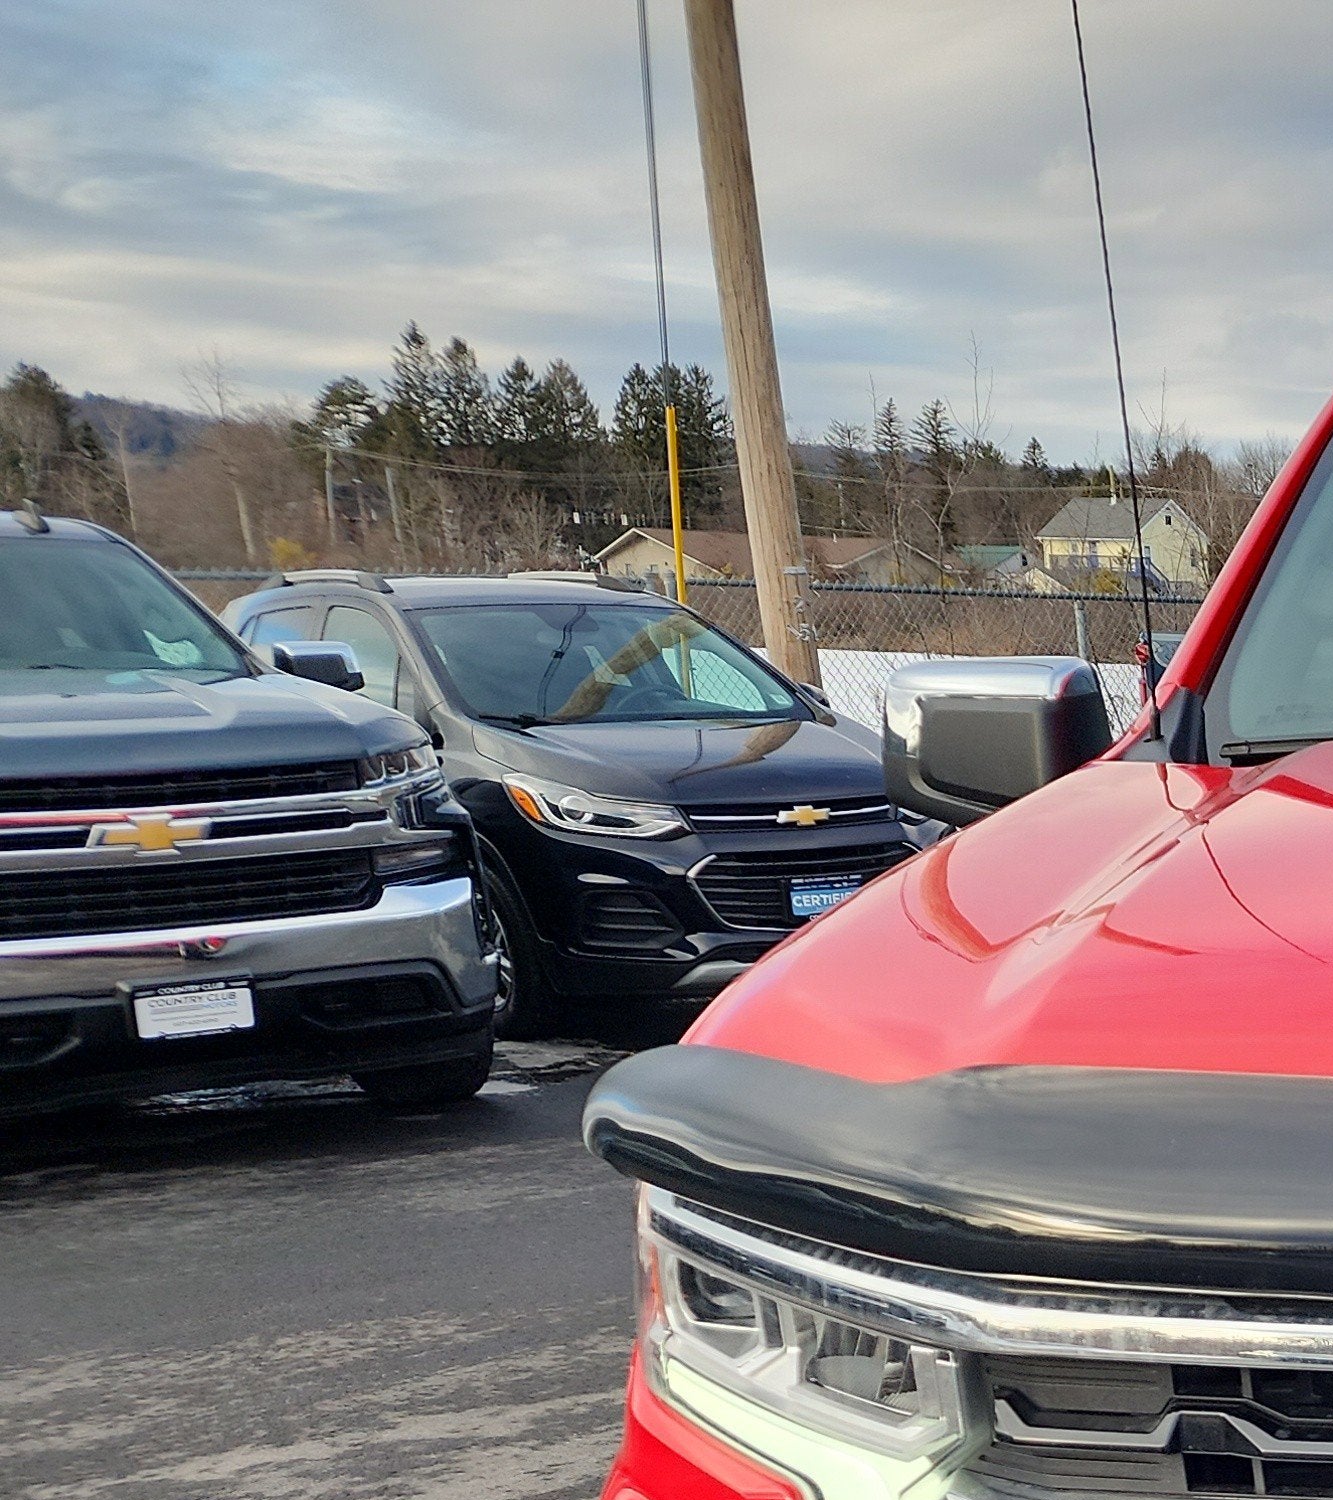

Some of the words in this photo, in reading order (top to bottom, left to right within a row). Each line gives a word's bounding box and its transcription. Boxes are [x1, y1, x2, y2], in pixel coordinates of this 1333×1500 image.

[792, 891, 852, 908] CERTIFI
[147, 995, 203, 1008] COUNTRY
[206, 991, 237, 1002] CLUB
